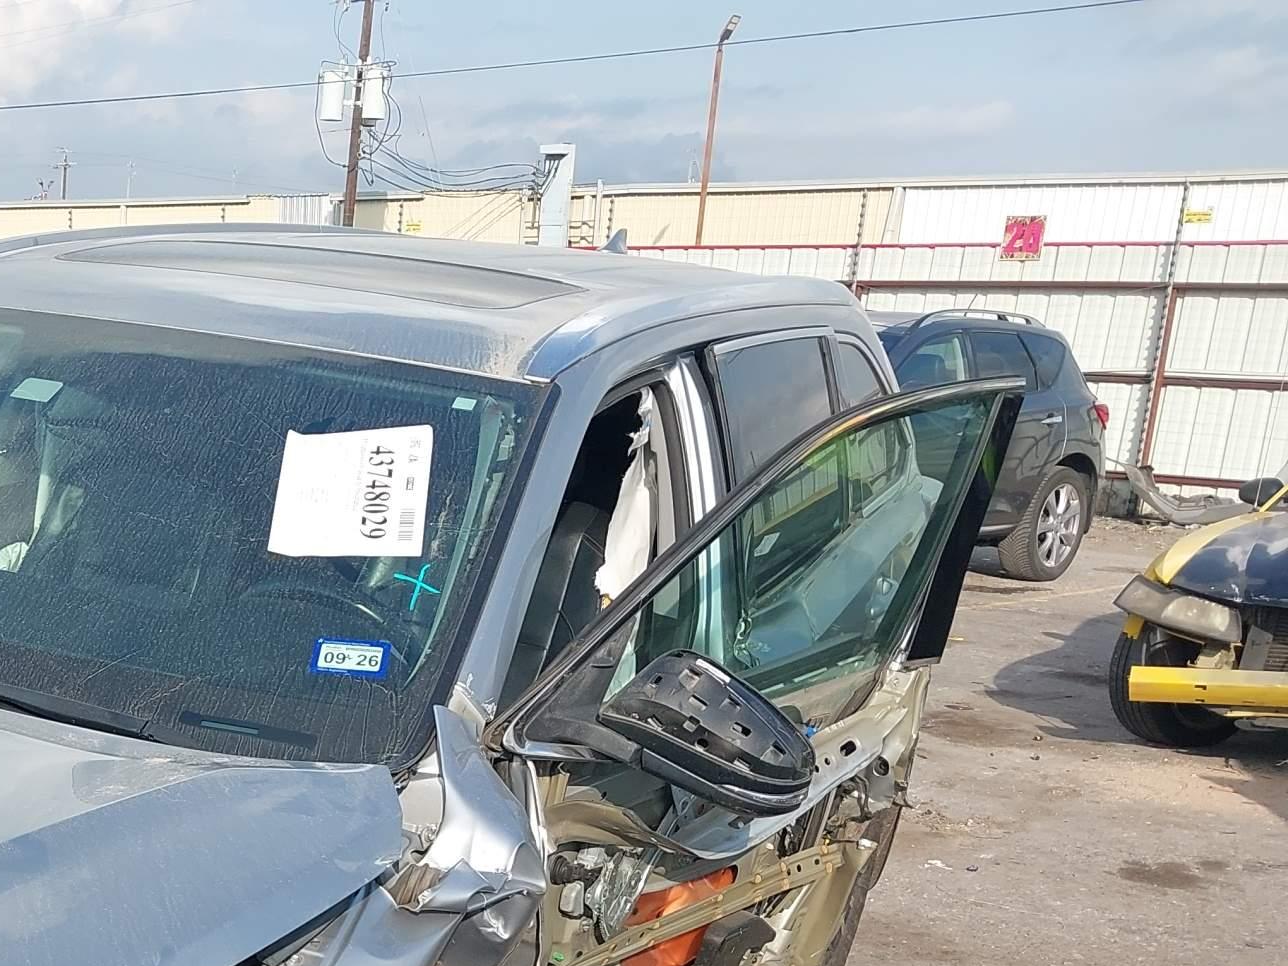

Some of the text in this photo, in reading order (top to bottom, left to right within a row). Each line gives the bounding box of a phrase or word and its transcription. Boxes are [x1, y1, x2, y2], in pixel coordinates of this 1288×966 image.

[360, 445, 395, 540] 43748029
[323, 651, 379, 667] 09 26
